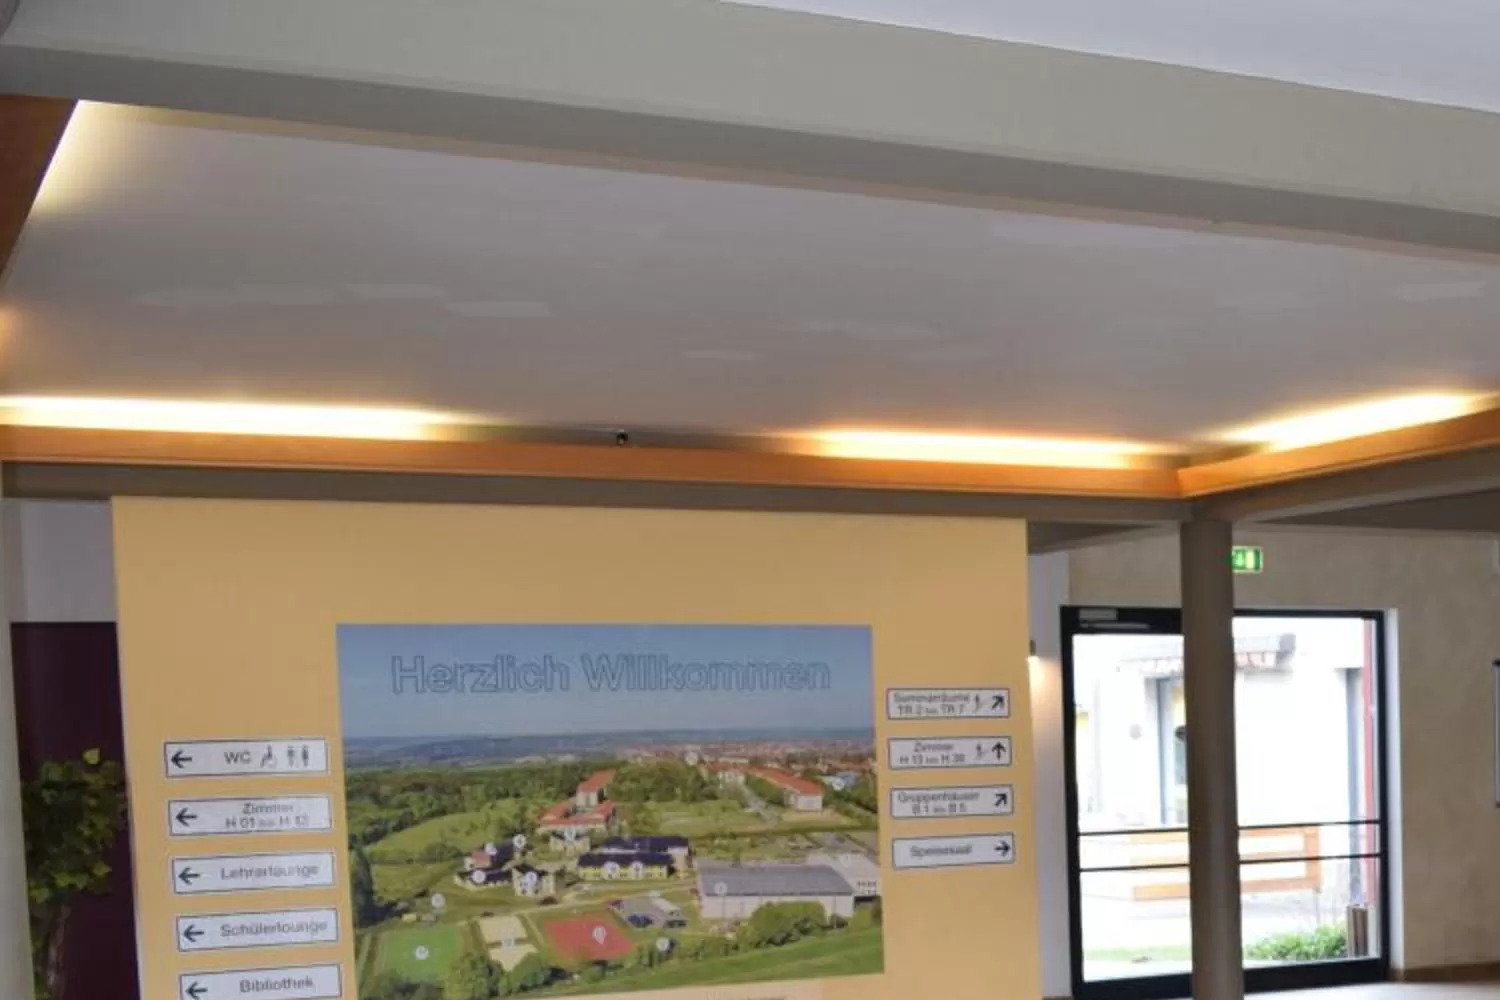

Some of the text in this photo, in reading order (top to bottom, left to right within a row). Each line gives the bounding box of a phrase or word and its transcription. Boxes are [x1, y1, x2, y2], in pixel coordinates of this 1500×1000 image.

[390, 653, 833, 694] Herzlich Willkommen
[223, 751, 252, 765] WC
[225, 818, 237, 829] H
[220, 920, 329, 937] Schülerlounge
[239, 976, 314, 993] Bibliothek
